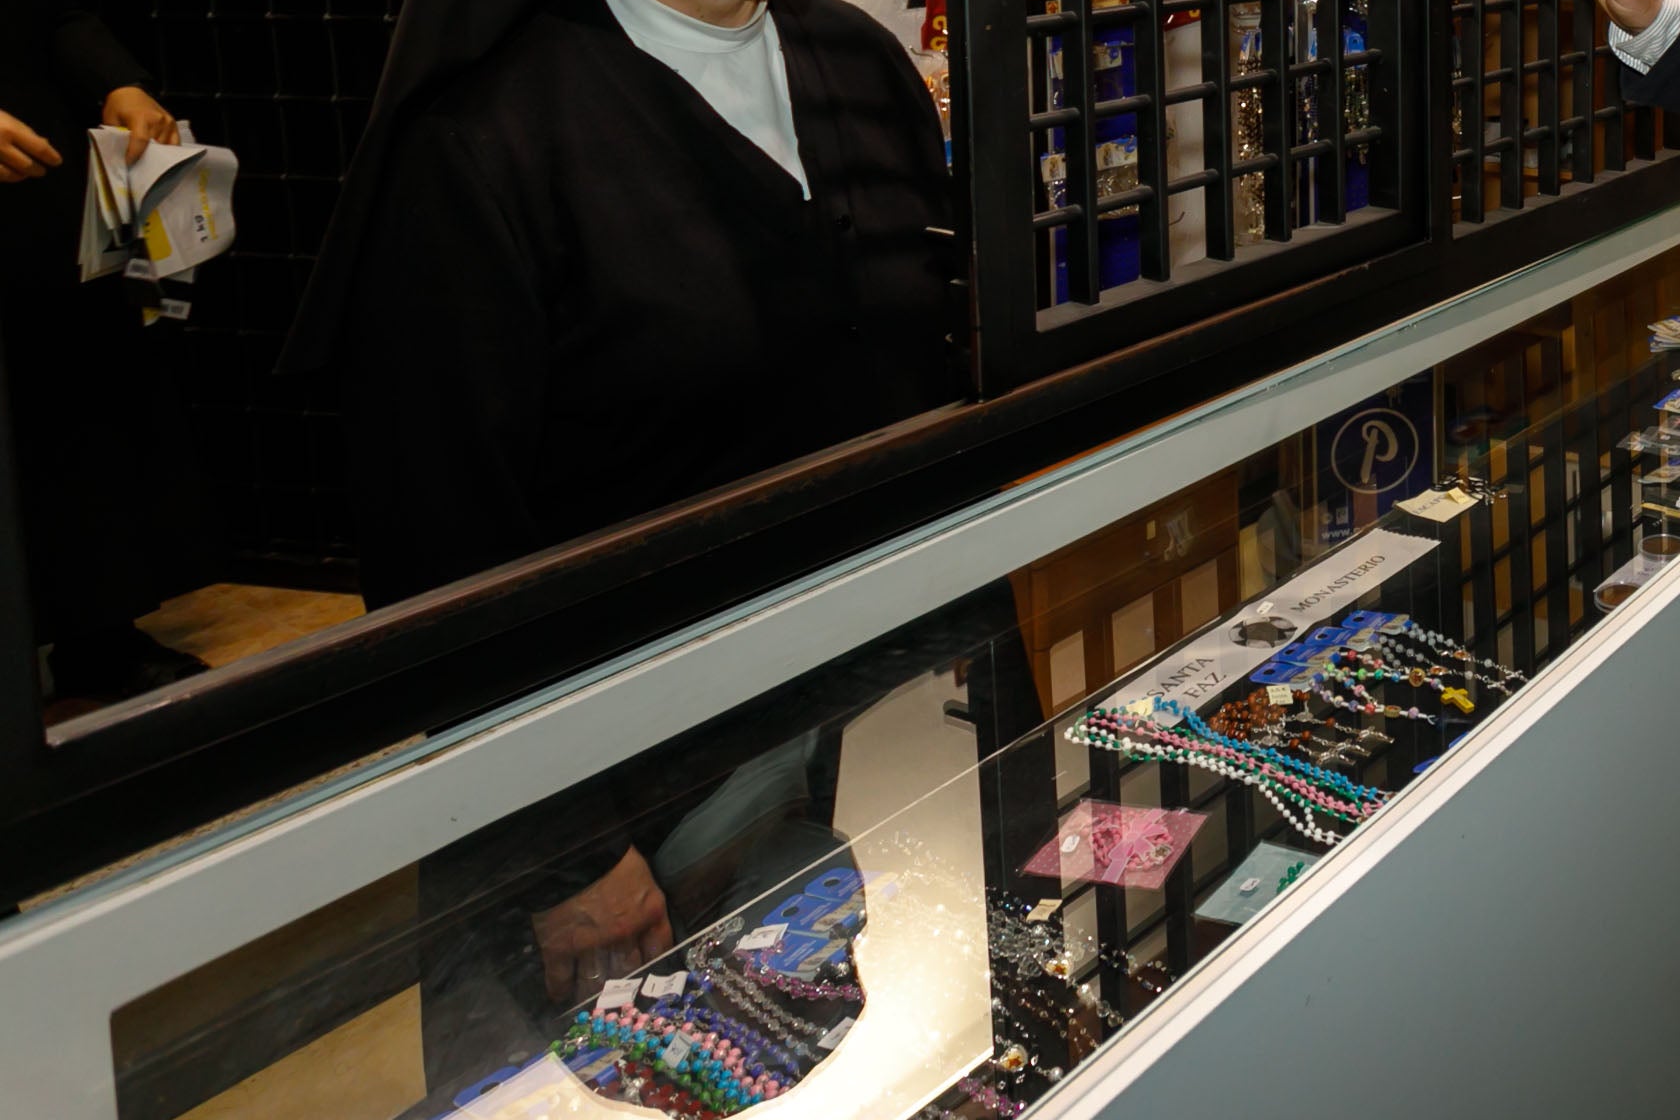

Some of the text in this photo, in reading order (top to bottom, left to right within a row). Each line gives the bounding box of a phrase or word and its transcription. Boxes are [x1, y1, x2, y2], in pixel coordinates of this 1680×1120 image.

[1360, 420, 1399, 485] P
[1289, 554, 1386, 614] MONASTERIO
[1146, 655, 1215, 698] SANTA
[1183, 671, 1229, 700] FAZ
